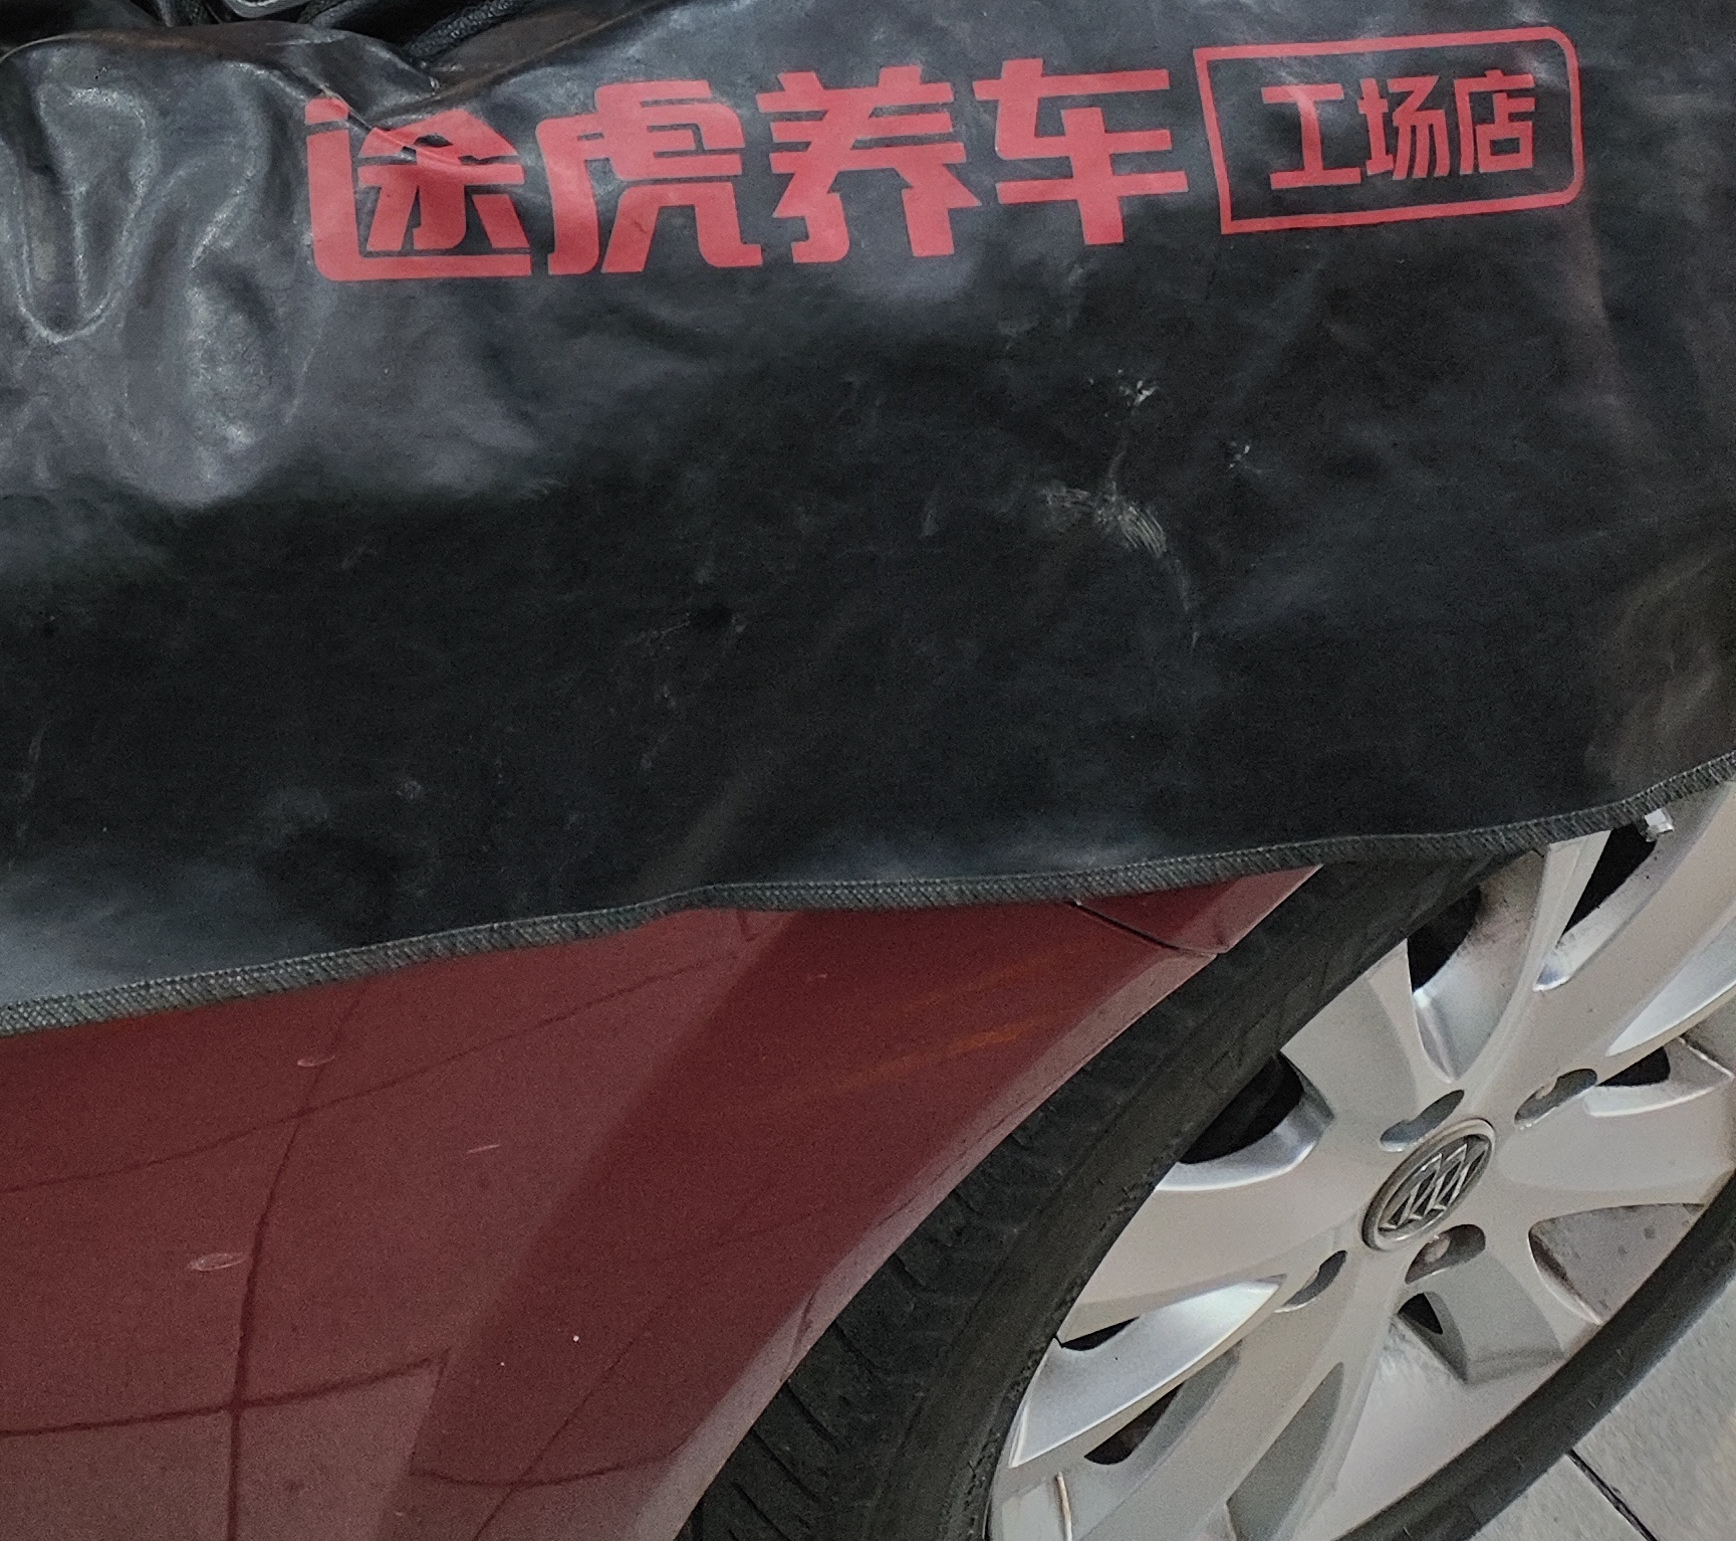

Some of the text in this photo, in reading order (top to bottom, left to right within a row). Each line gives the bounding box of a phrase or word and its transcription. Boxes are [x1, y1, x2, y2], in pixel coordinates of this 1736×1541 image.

[307, 59, 1535, 281] 途虎养车 工场店
